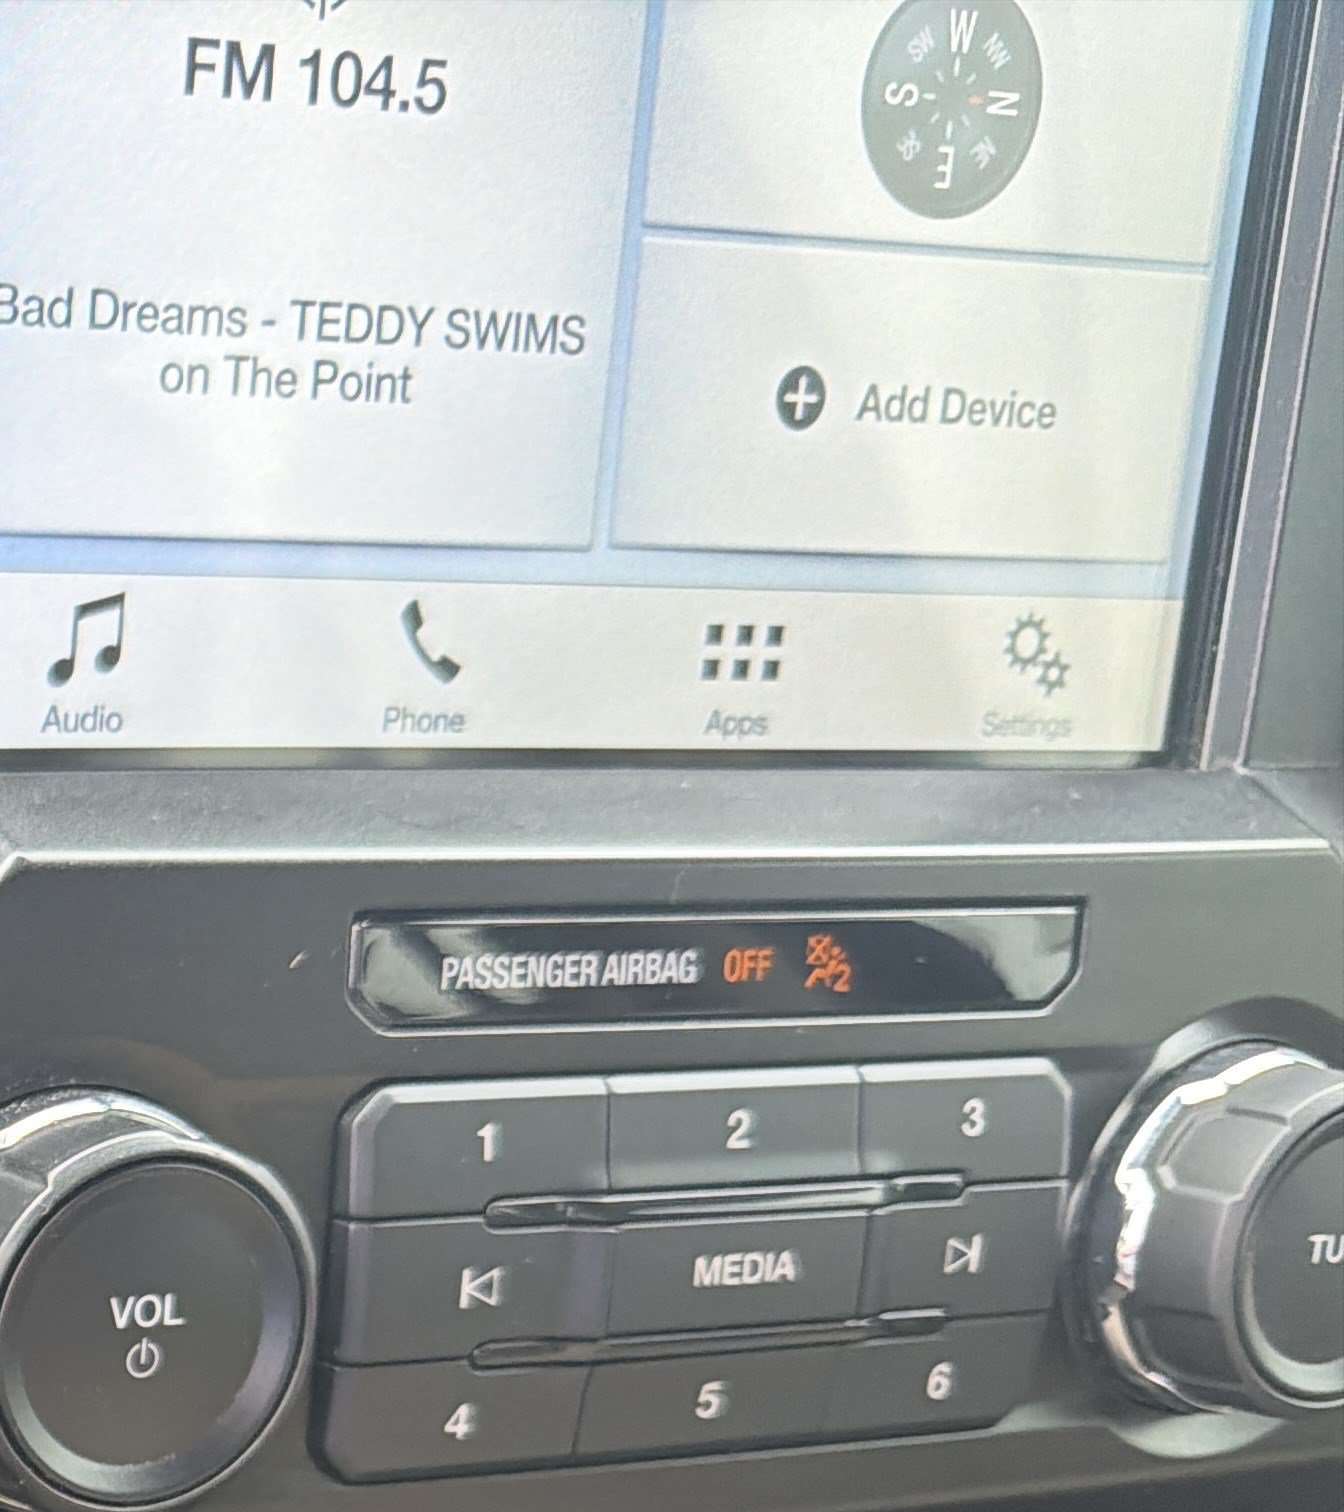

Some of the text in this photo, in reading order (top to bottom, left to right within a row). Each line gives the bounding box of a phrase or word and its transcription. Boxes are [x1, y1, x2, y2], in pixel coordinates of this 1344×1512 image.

[950, 7, 979, 54] W
[183, 37, 449, 115] FM 104.5
[884, 81, 920, 107] S
[986, 90, 1021, 116] N
[932, 145, 955, 190] E
[87, 288, 248, 338] Dreams
[290, 300, 435, 349] TEDDY
[444, 310, 587, 356] SWIMS
[159, 355, 414, 404] on The Point
[854, 383, 1058, 431] Add Device
[40, 704, 124, 735] Audio
[382, 706, 467, 736] Phone
[703, 710, 770, 738] Apps
[981, 710, 1073, 739] Settings
[440, 947, 699, 991] PASSENGER AIRBAG
[722, 948, 774, 984] OFF
[727, 1108, 754, 1149] 2
[960, 1098, 987, 1137] 3
[476, 1122, 501, 1162] 1
[692, 1249, 797, 1289] MEDIA
[110, 1293, 186, 1330] VOL
[926, 1360, 954, 1400] 6
[694, 1381, 725, 1419] 5
[444, 1402, 478, 1440] 4
